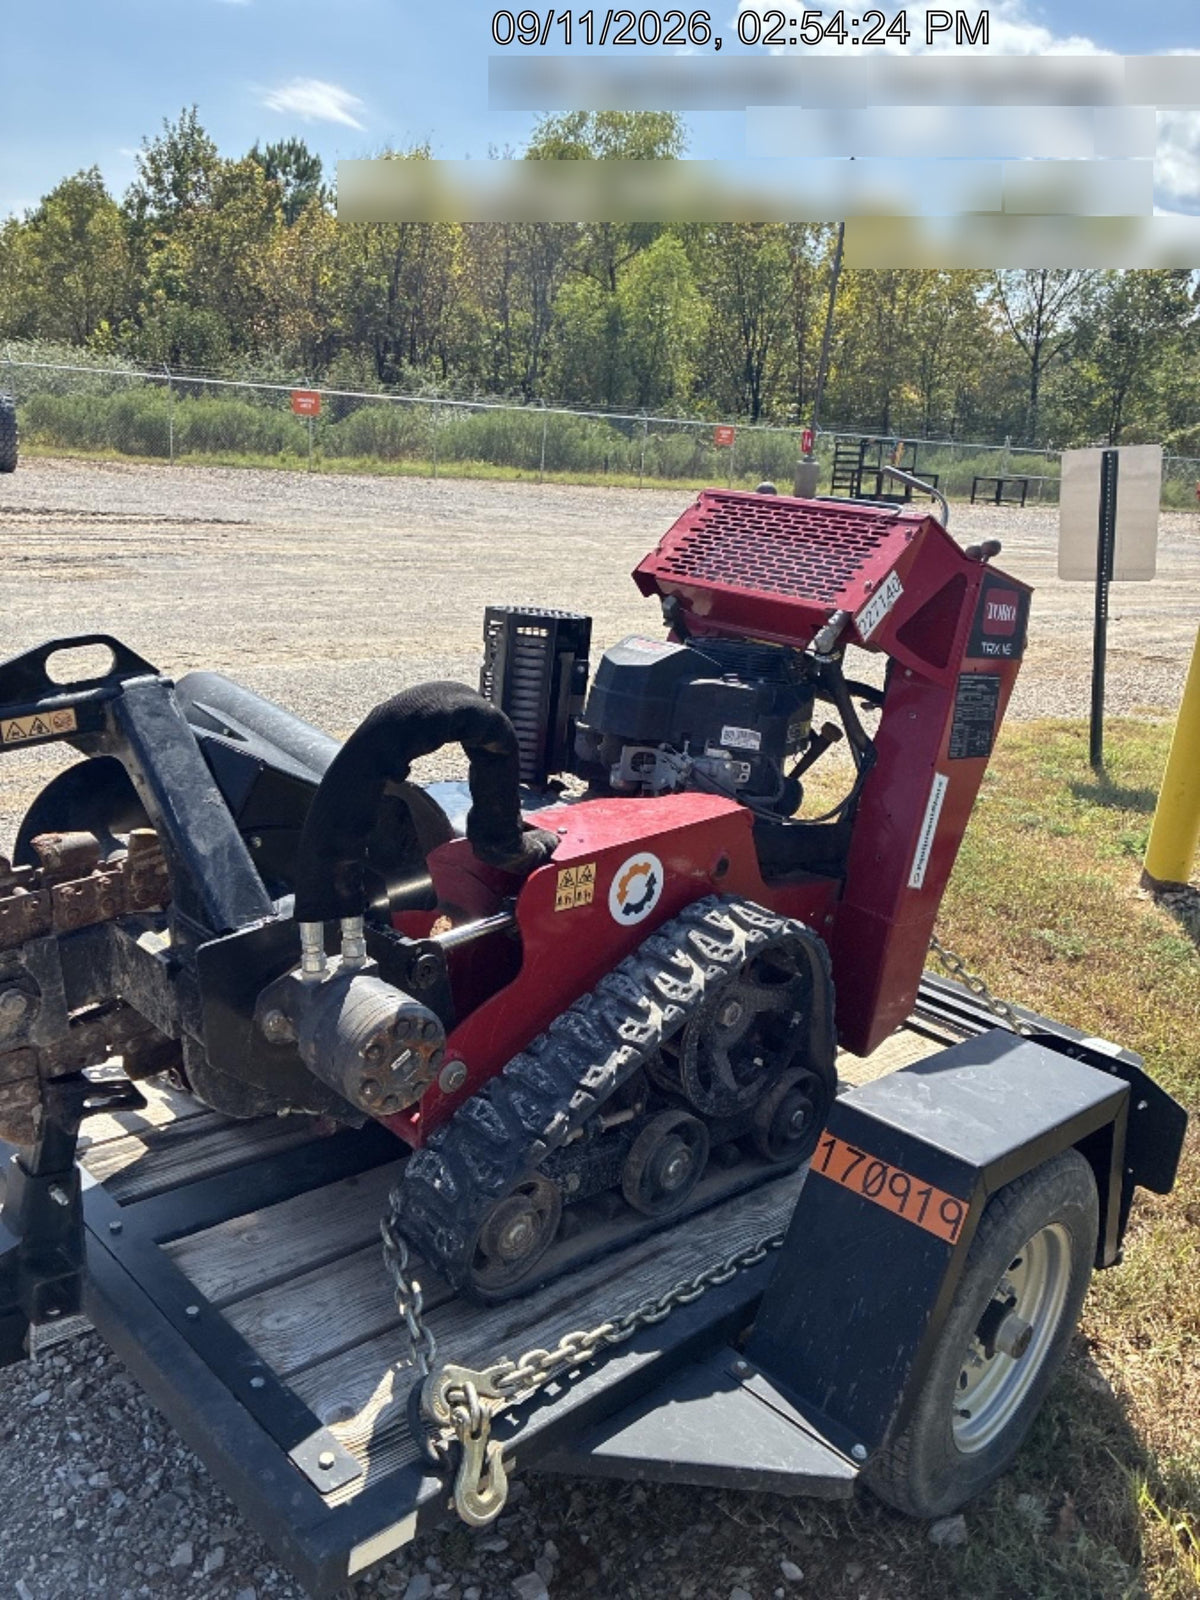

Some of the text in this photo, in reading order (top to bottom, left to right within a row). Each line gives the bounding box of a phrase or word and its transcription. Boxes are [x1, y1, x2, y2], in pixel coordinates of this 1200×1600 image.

[859, 575, 902, 635] 227140
[986, 602, 1016, 622] TORO
[981, 641, 1000, 655] TRX
[820, 1138, 963, 1241] 170919
